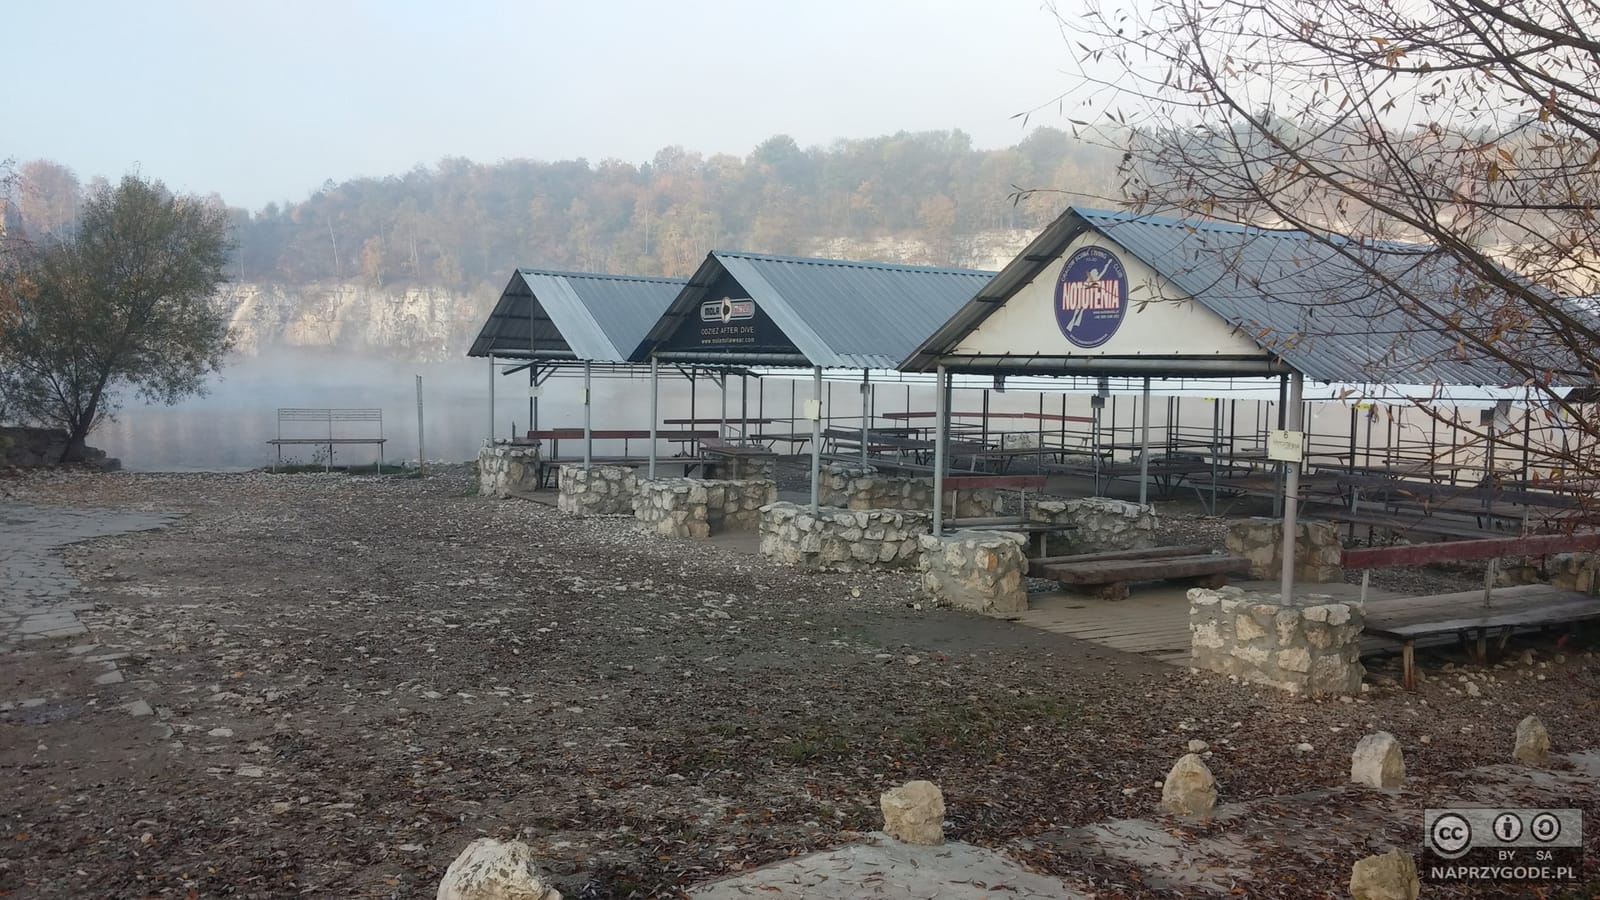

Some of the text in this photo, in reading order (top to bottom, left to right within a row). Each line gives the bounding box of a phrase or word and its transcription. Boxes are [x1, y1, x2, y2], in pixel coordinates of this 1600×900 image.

[1062, 279, 1119, 310] NOTOTENIA
[720, 327, 739, 335] AFTER
[740, 326, 754, 334] DIVE
